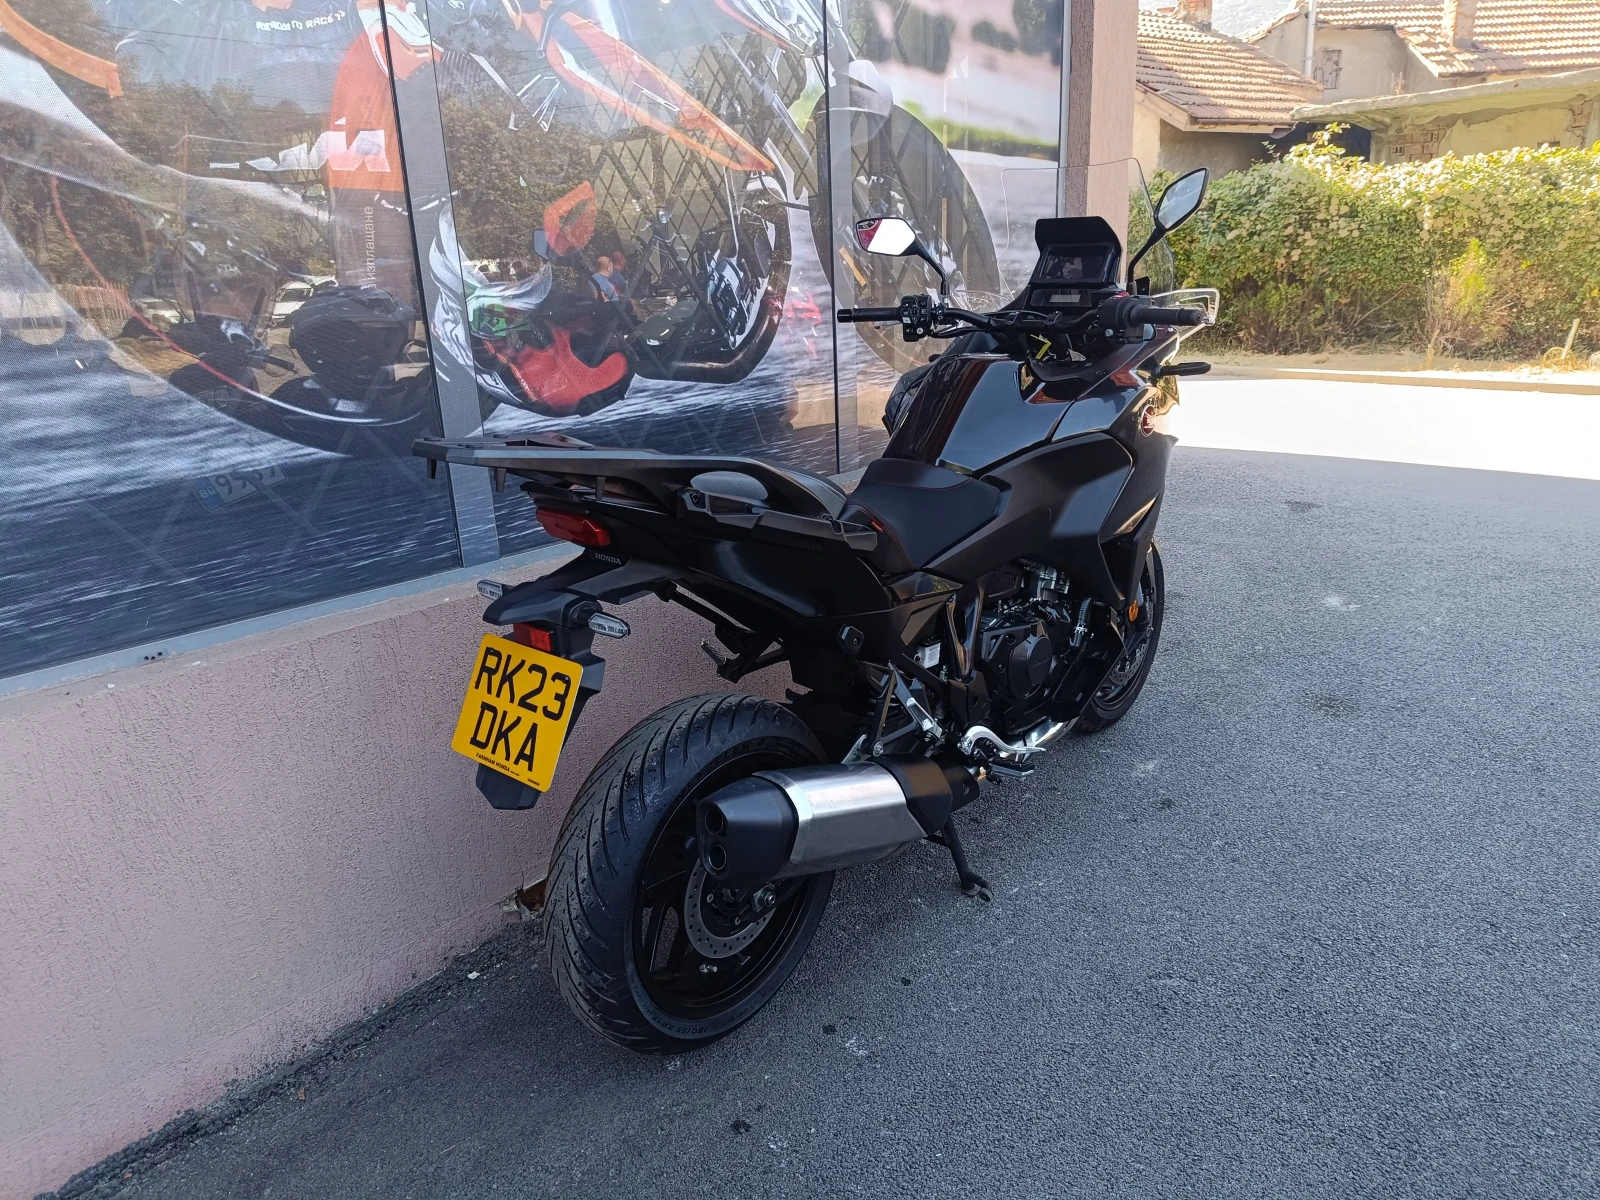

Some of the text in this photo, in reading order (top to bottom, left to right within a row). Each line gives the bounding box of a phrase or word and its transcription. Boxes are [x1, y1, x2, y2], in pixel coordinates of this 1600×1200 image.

[305, 15, 334, 29] RACE
[363, 206, 377, 282] изплащане
[594, 552, 622, 565] HONDA
[474, 646, 572, 722] RK23
[469, 701, 539, 772] DKA
[475, 752, 510, 772] FARNHAM HONDA
[675, 1026, 707, 1035] 180/55
